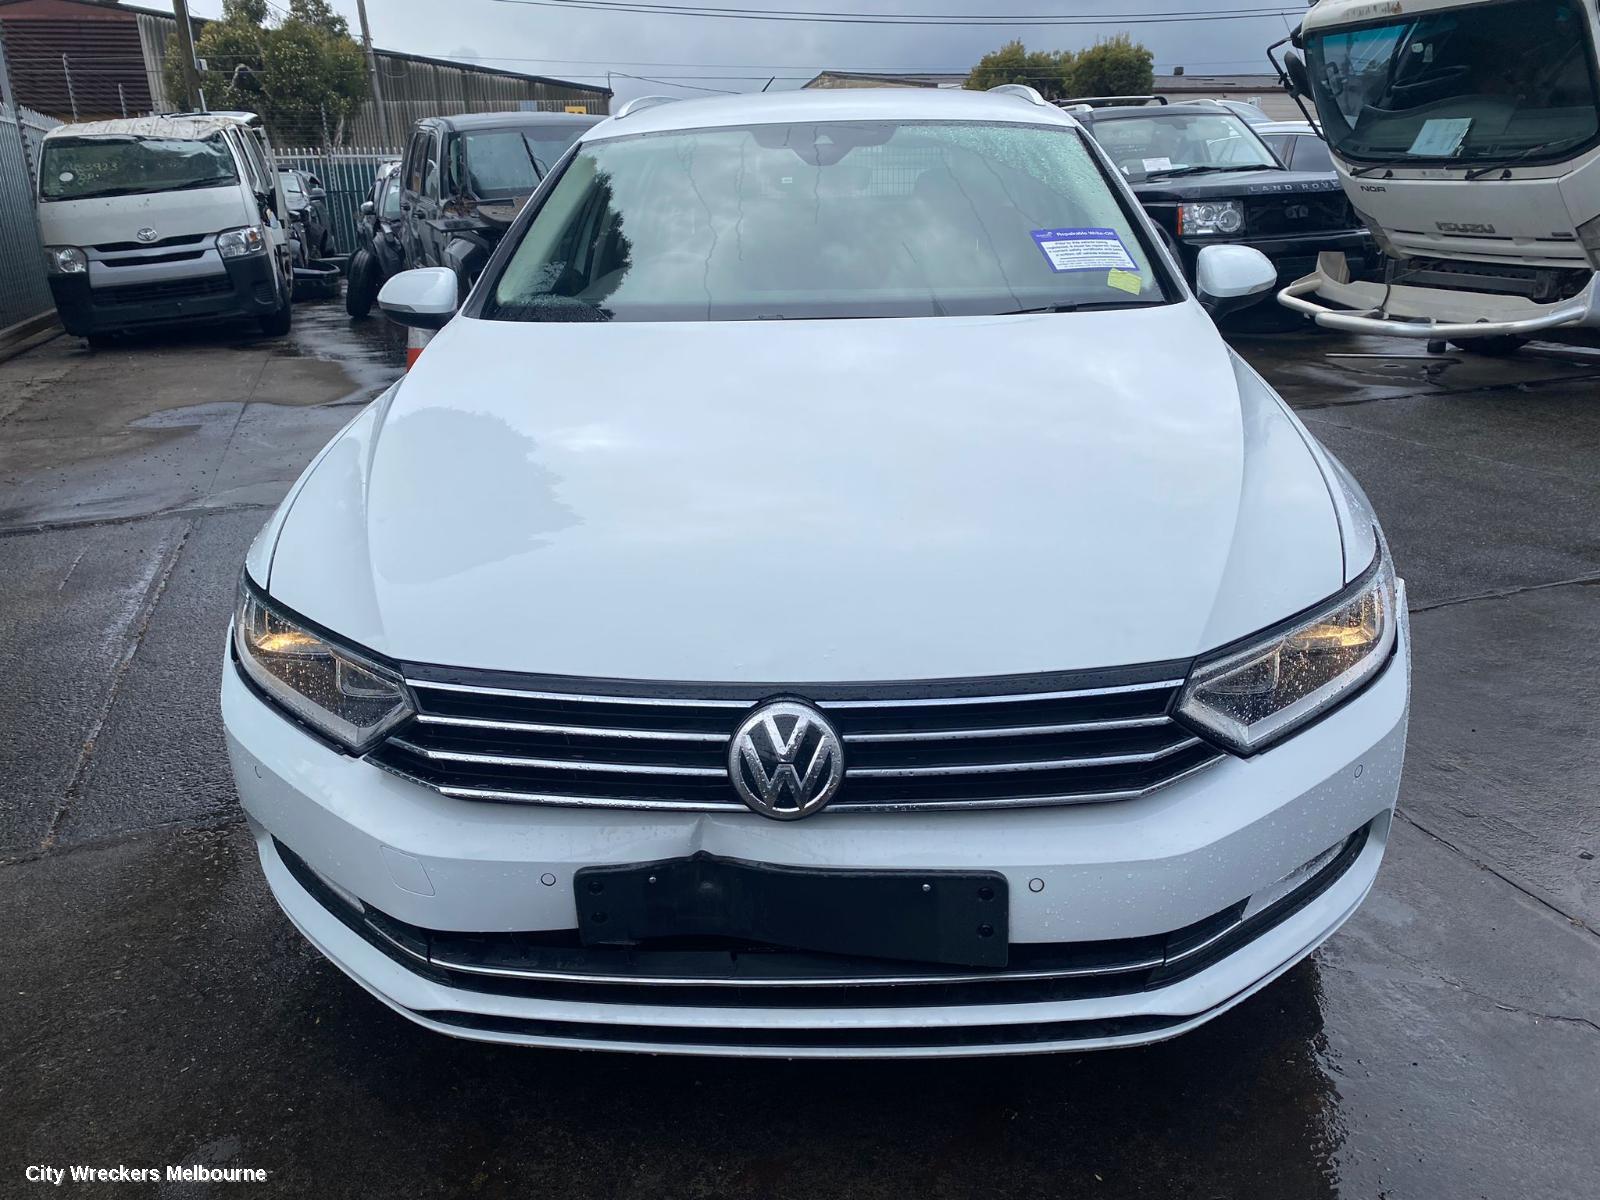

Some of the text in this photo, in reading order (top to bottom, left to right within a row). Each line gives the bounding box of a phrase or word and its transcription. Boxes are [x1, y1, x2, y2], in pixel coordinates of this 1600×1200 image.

[1250, 180, 1342, 192] LAND ROVE
[1435, 221, 1496, 234] ISUZU
